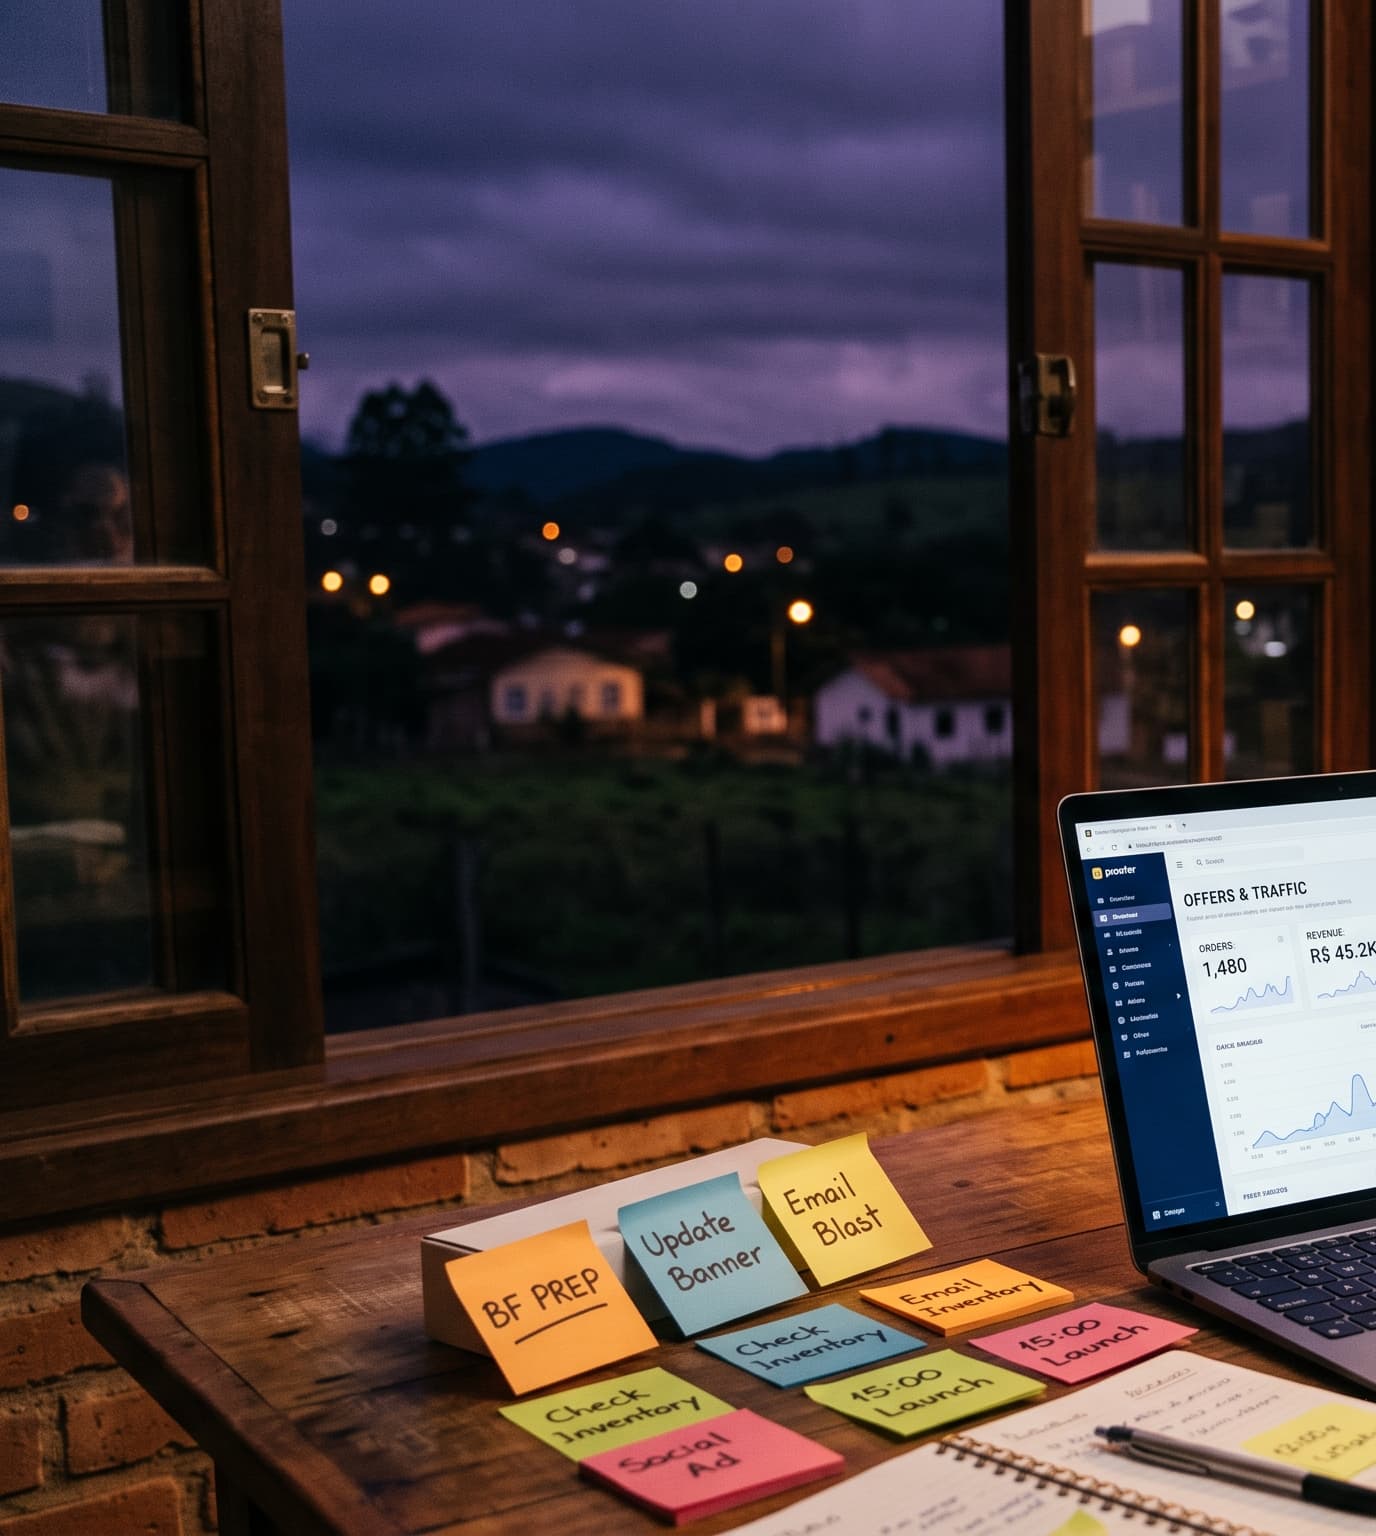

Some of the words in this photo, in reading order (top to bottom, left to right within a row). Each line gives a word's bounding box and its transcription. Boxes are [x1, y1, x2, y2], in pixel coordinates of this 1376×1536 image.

[1184, 888, 1236, 907] OFFERS
[1239, 887, 1249, 901] &
[1251, 881, 1308, 900] TRAFFIC
[1202, 957, 1248, 980] 1,480
[1310, 945, 1331, 964] R$
[783, 1171, 857, 1215] Email
[640, 1211, 735, 1258] Update
[812, 1204, 882, 1246] Blast
[667, 1246, 762, 1292] Banner
[482, 1294, 522, 1329] BF
[531, 1267, 600, 1310] PREP
[899, 1278, 983, 1306] Email
[918, 1280, 1046, 1317] Inventory
[736, 1325, 829, 1357] Check
[752, 1328, 889, 1371] Inventory
[1018, 1319, 1101, 1352] 15:00
[1040, 1323, 1150, 1367] Launch
[850, 1369, 943, 1403] 15:00
[874, 1378, 995, 1417] Launch
[545, 1387, 651, 1424] Check
[553, 1395, 702, 1444] Inventory
[618, 1431, 733, 1473] Social
[687, 1451, 742, 1478] Ad
